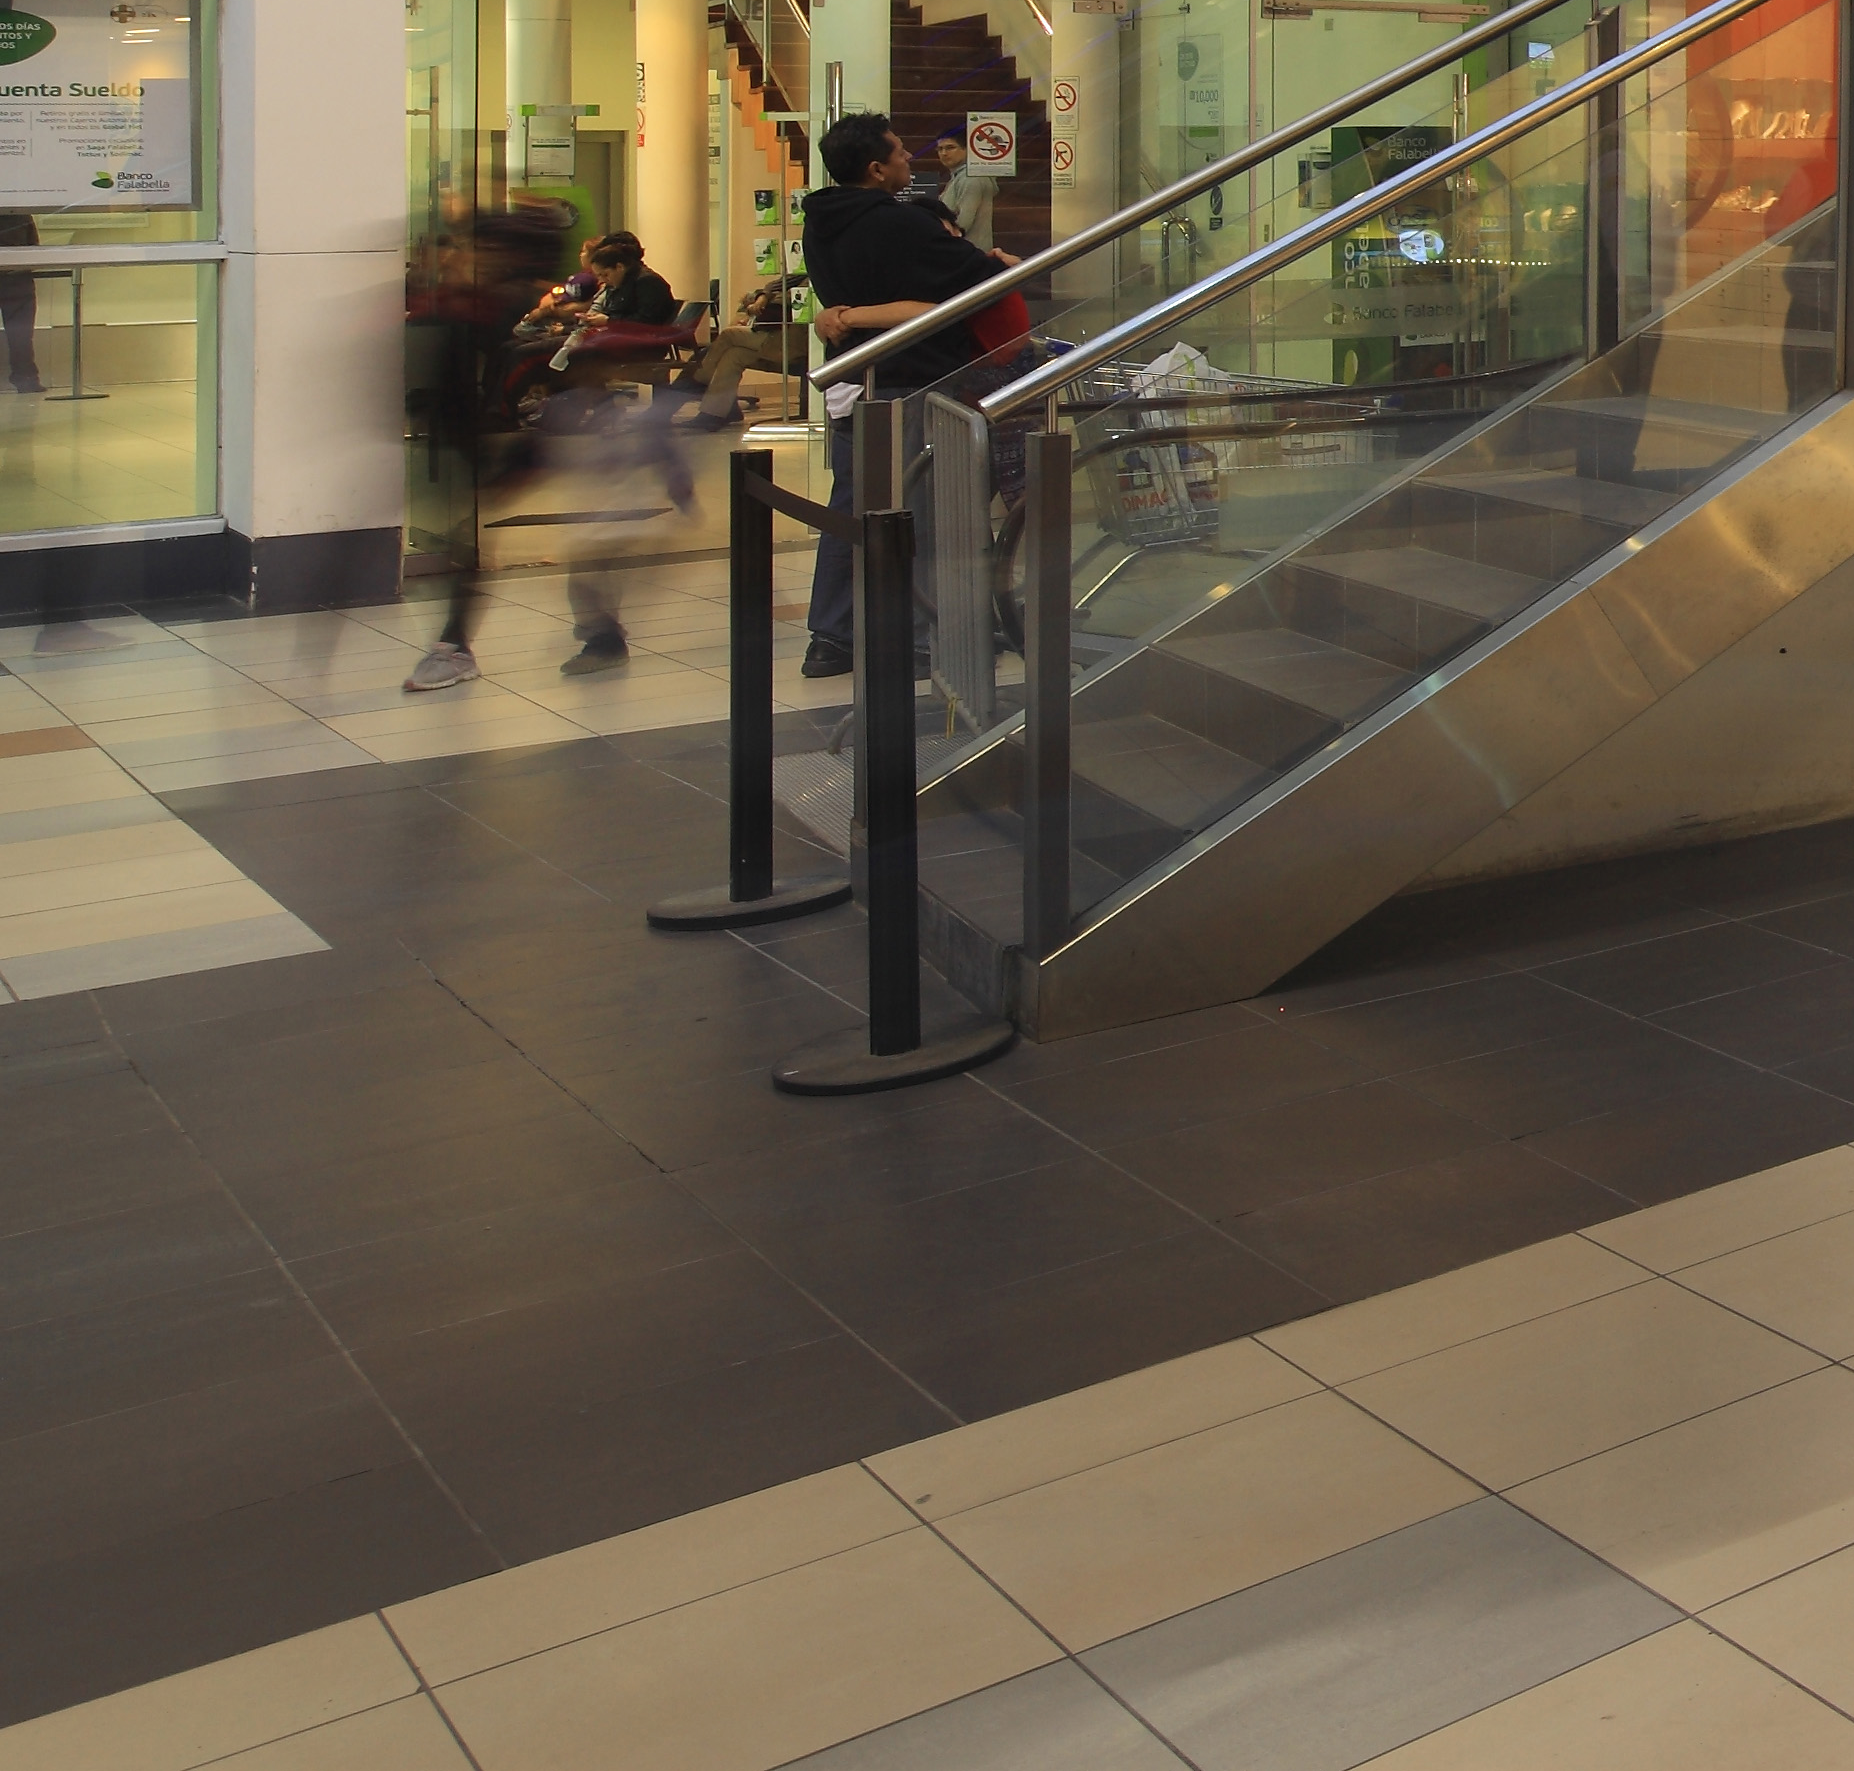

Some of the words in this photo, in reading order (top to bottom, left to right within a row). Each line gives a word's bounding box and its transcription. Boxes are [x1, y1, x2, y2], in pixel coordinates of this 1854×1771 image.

[16, 22, 41, 31] DÍAS
[69, 83, 145, 97] Sueldo
[117, 180, 170, 189] Falabella
